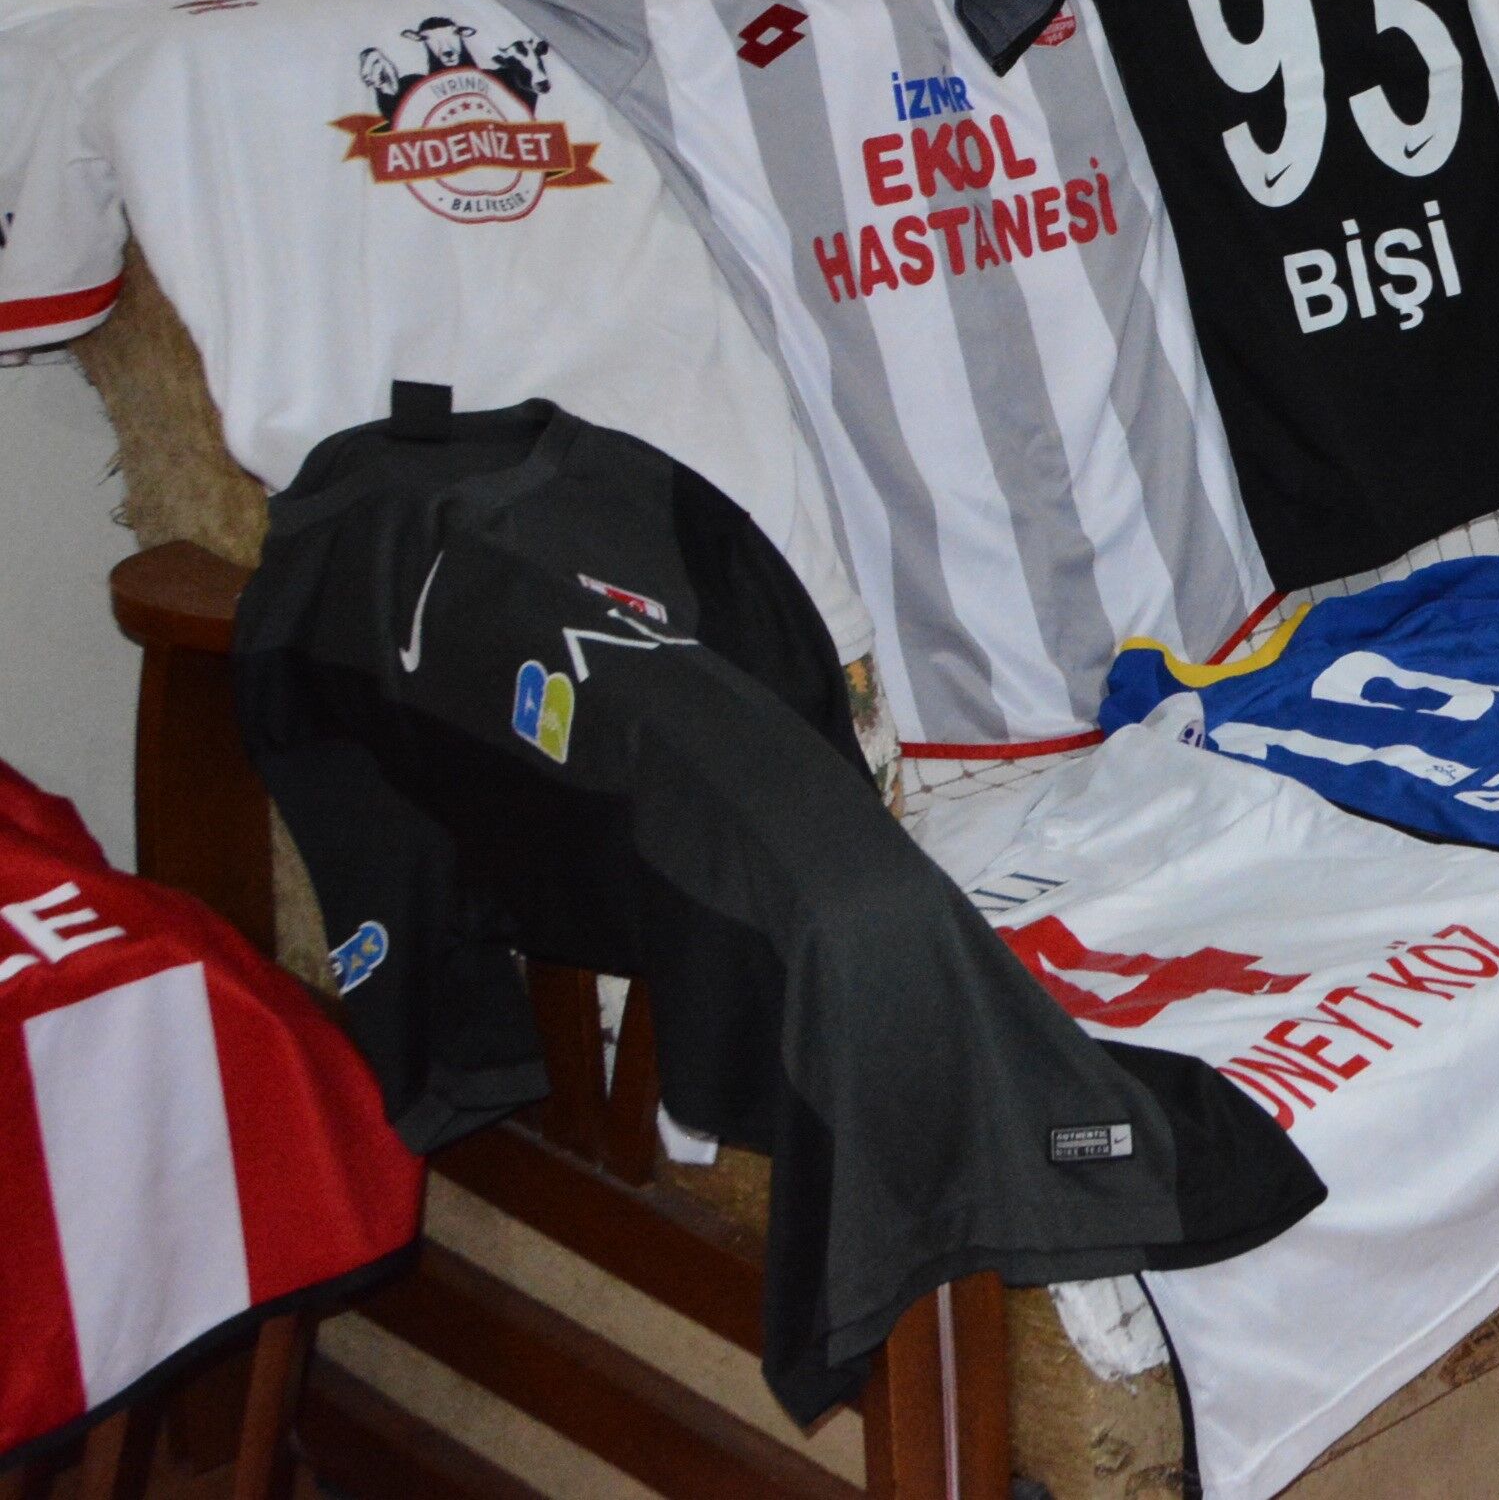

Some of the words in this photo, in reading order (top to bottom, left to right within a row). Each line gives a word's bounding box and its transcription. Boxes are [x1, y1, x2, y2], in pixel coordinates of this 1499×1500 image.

[386, 124, 514, 173] AYDENİZ
[516, 132, 552, 162] ET
[861, 113, 1037, 207] EKOL
[812, 156, 1118, 304] HASTANESİ
[1282, 201, 1463, 334] BİŞİ
